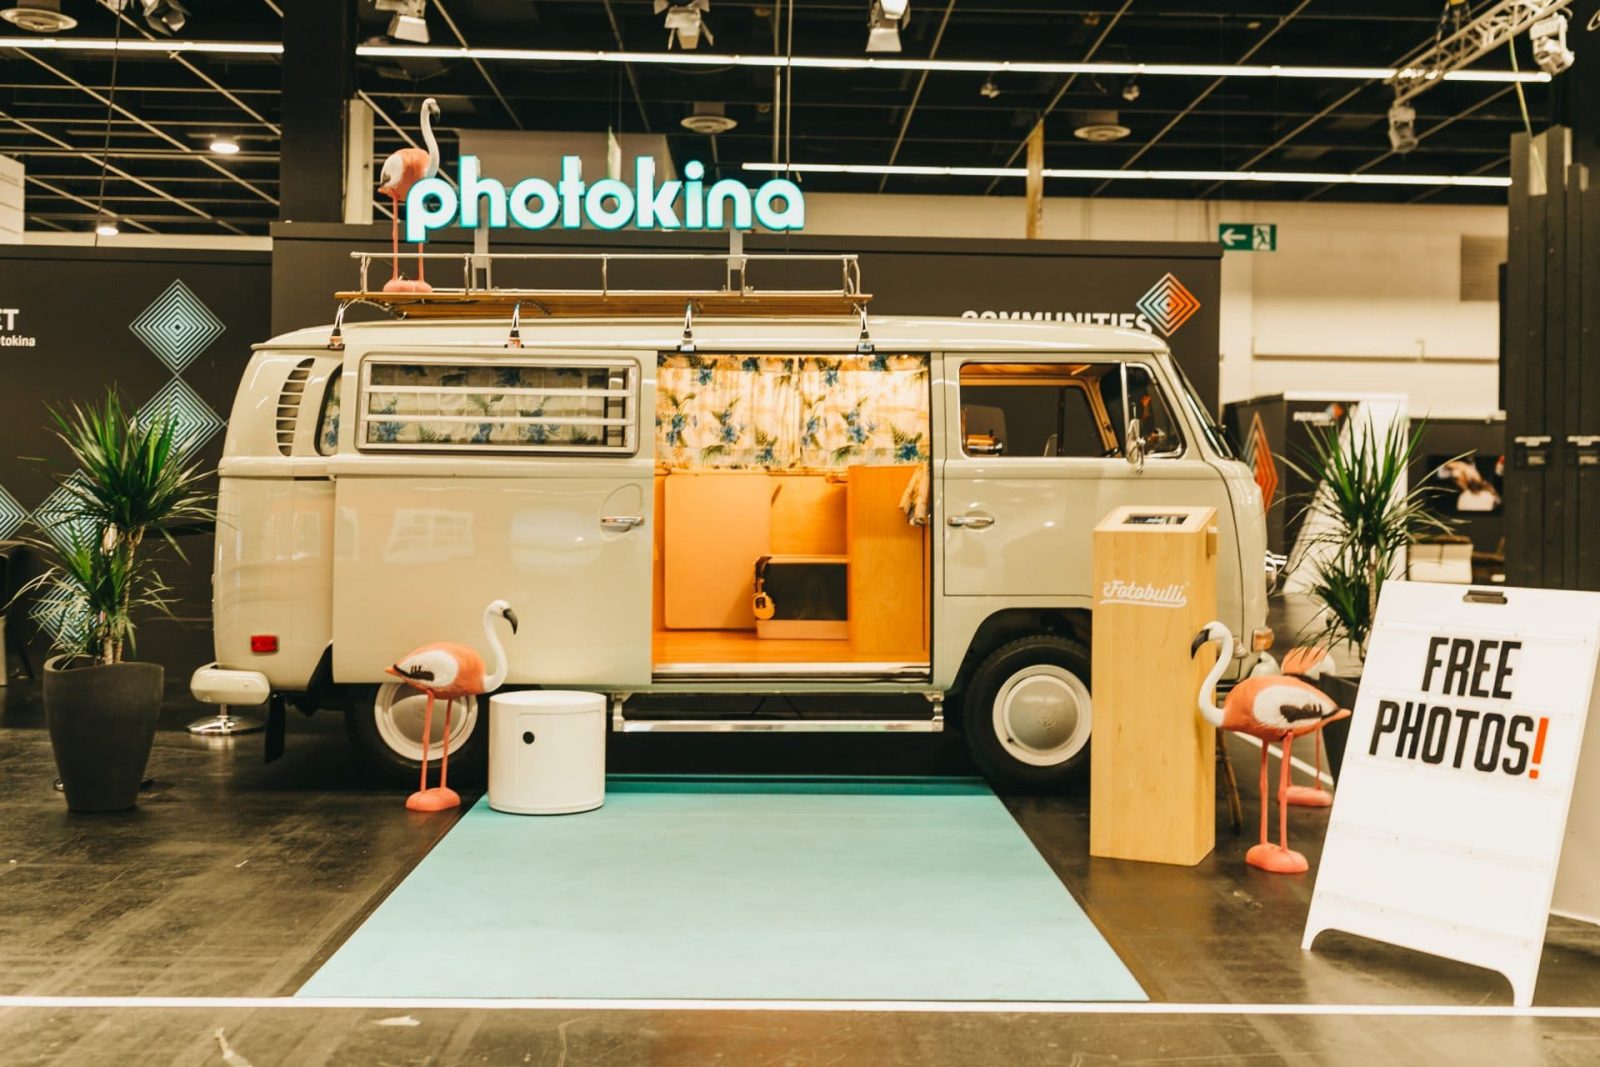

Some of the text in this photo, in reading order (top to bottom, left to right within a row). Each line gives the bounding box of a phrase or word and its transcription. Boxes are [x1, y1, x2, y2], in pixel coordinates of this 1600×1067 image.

[406, 155, 806, 243] photokina
[0, 308, 20, 331] T
[0, 335, 36, 347] tokina
[1421, 636, 1522, 700] FREE
[1368, 699, 1549, 779] PHOTOS!
